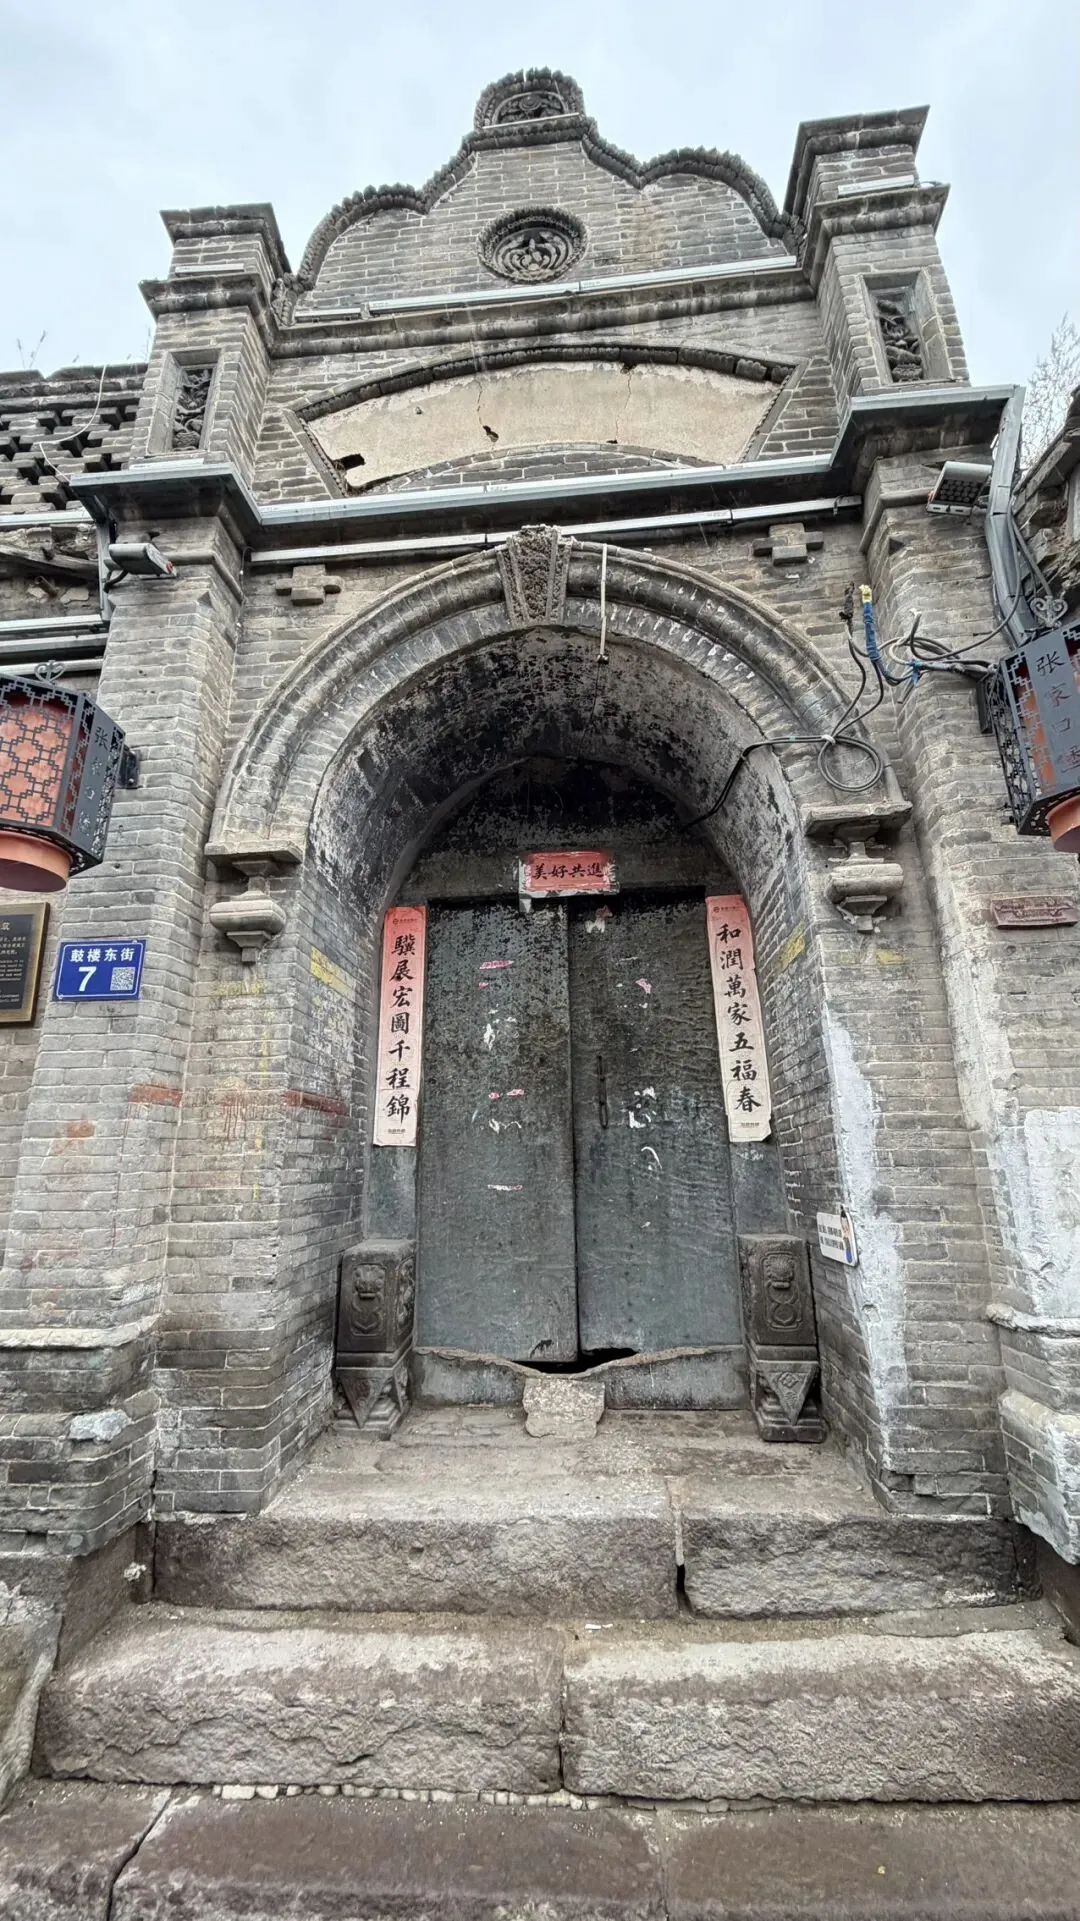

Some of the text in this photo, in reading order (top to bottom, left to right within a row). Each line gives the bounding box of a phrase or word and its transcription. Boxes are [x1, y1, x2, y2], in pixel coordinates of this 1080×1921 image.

[532, 862, 605, 880] 美好共進
[70, 947, 135, 963] 鼓楼东街
[78, 966, 97, 992] 7
[716, 923, 761, 1113] 和潤萬家五福春
